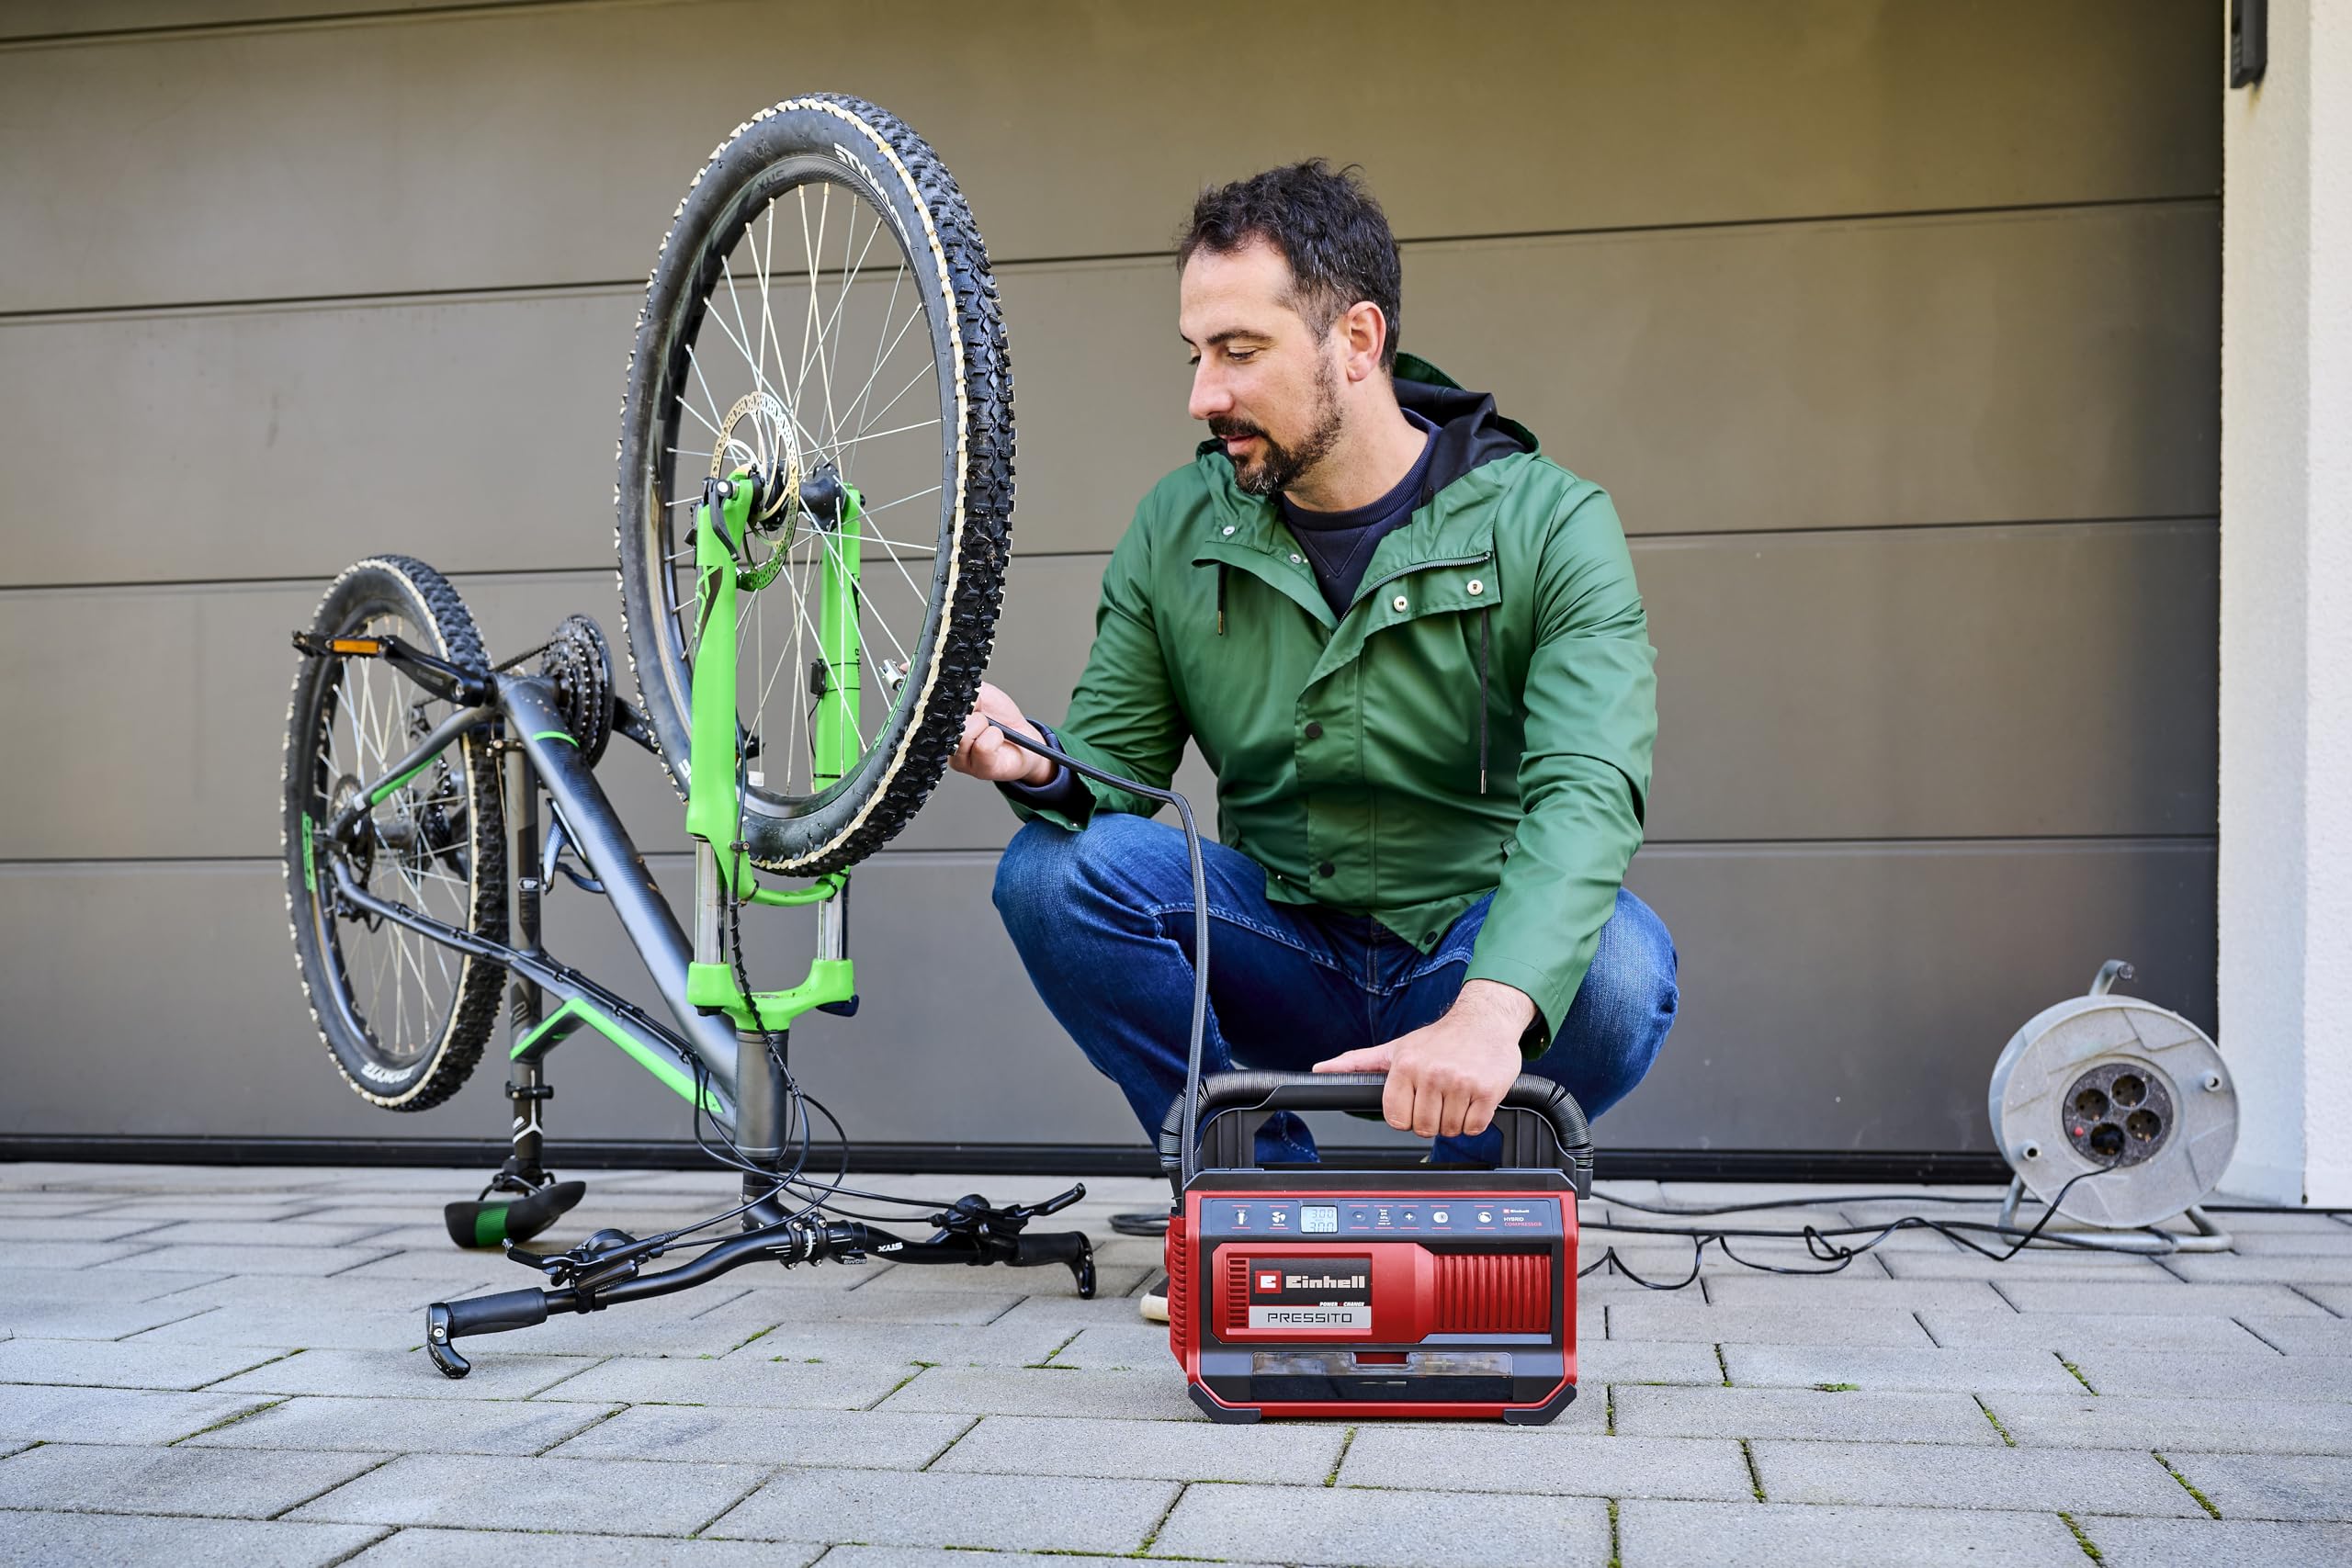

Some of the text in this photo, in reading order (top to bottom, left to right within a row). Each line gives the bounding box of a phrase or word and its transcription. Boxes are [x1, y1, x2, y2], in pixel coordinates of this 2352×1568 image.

[877, 1242, 904, 1252] STYX
[1285, 1275, 1365, 1289] Einhell
[1267, 1313, 1352, 1323] PRESSITO
